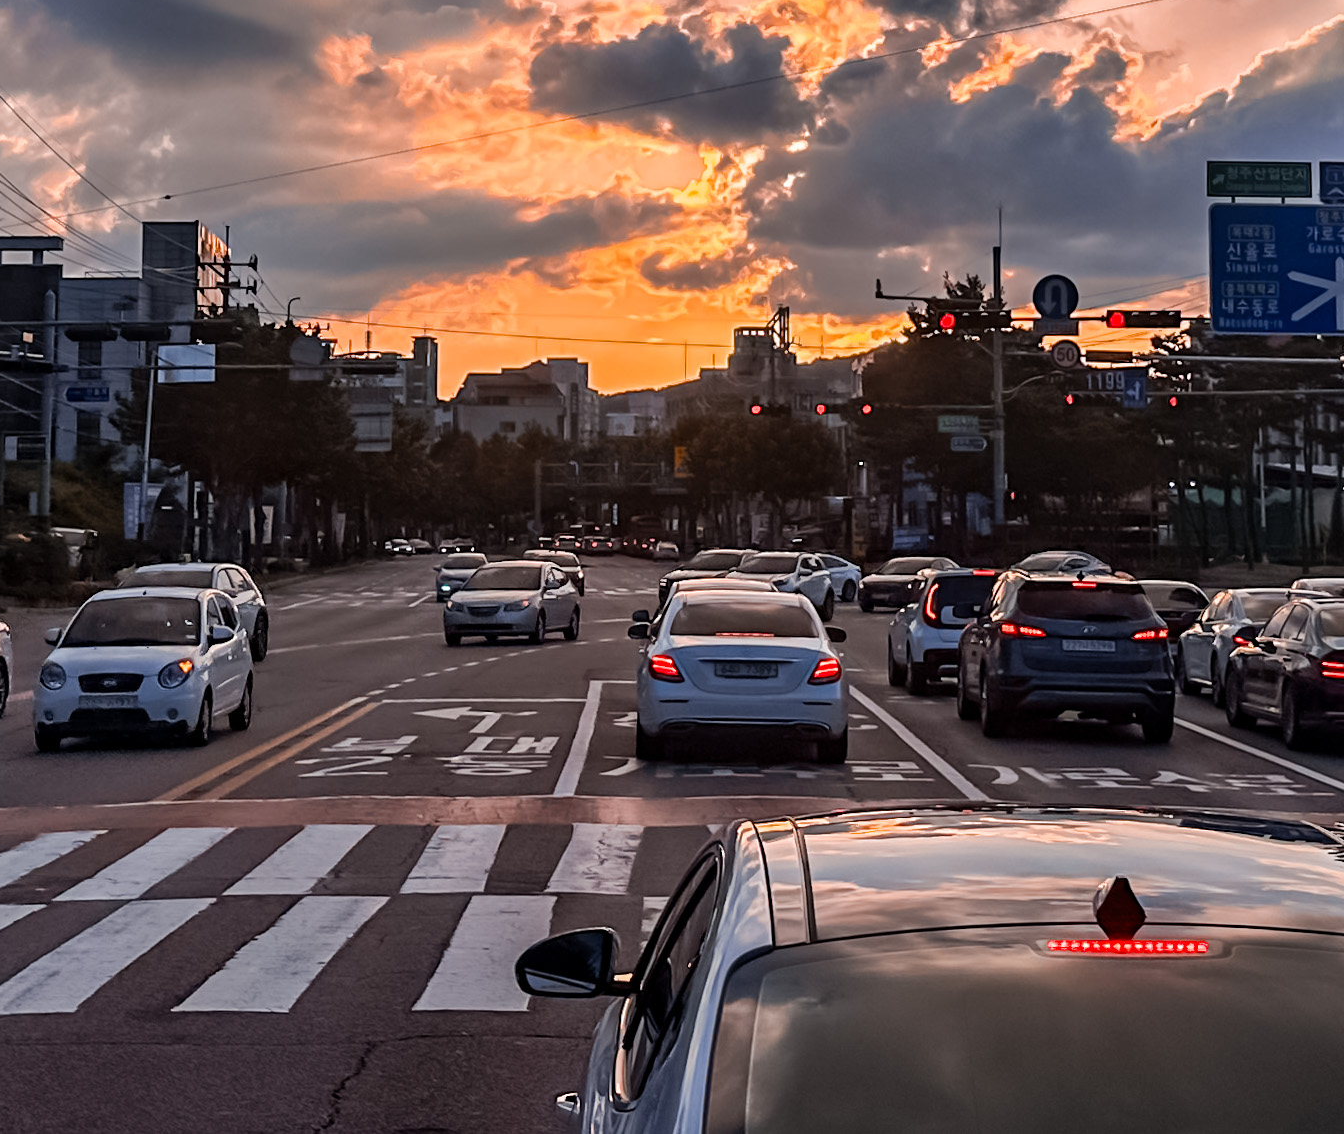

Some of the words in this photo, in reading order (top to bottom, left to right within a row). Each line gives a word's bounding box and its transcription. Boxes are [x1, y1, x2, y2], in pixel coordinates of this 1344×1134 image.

[1226, 243, 1278, 263] 신율로
[1225, 262, 1279, 274] Sinyul-ro
[1222, 299, 1280, 317] 내수동로
[1056, 347, 1075, 362] 50
[967, 764, 1336, 796] 가로수로
